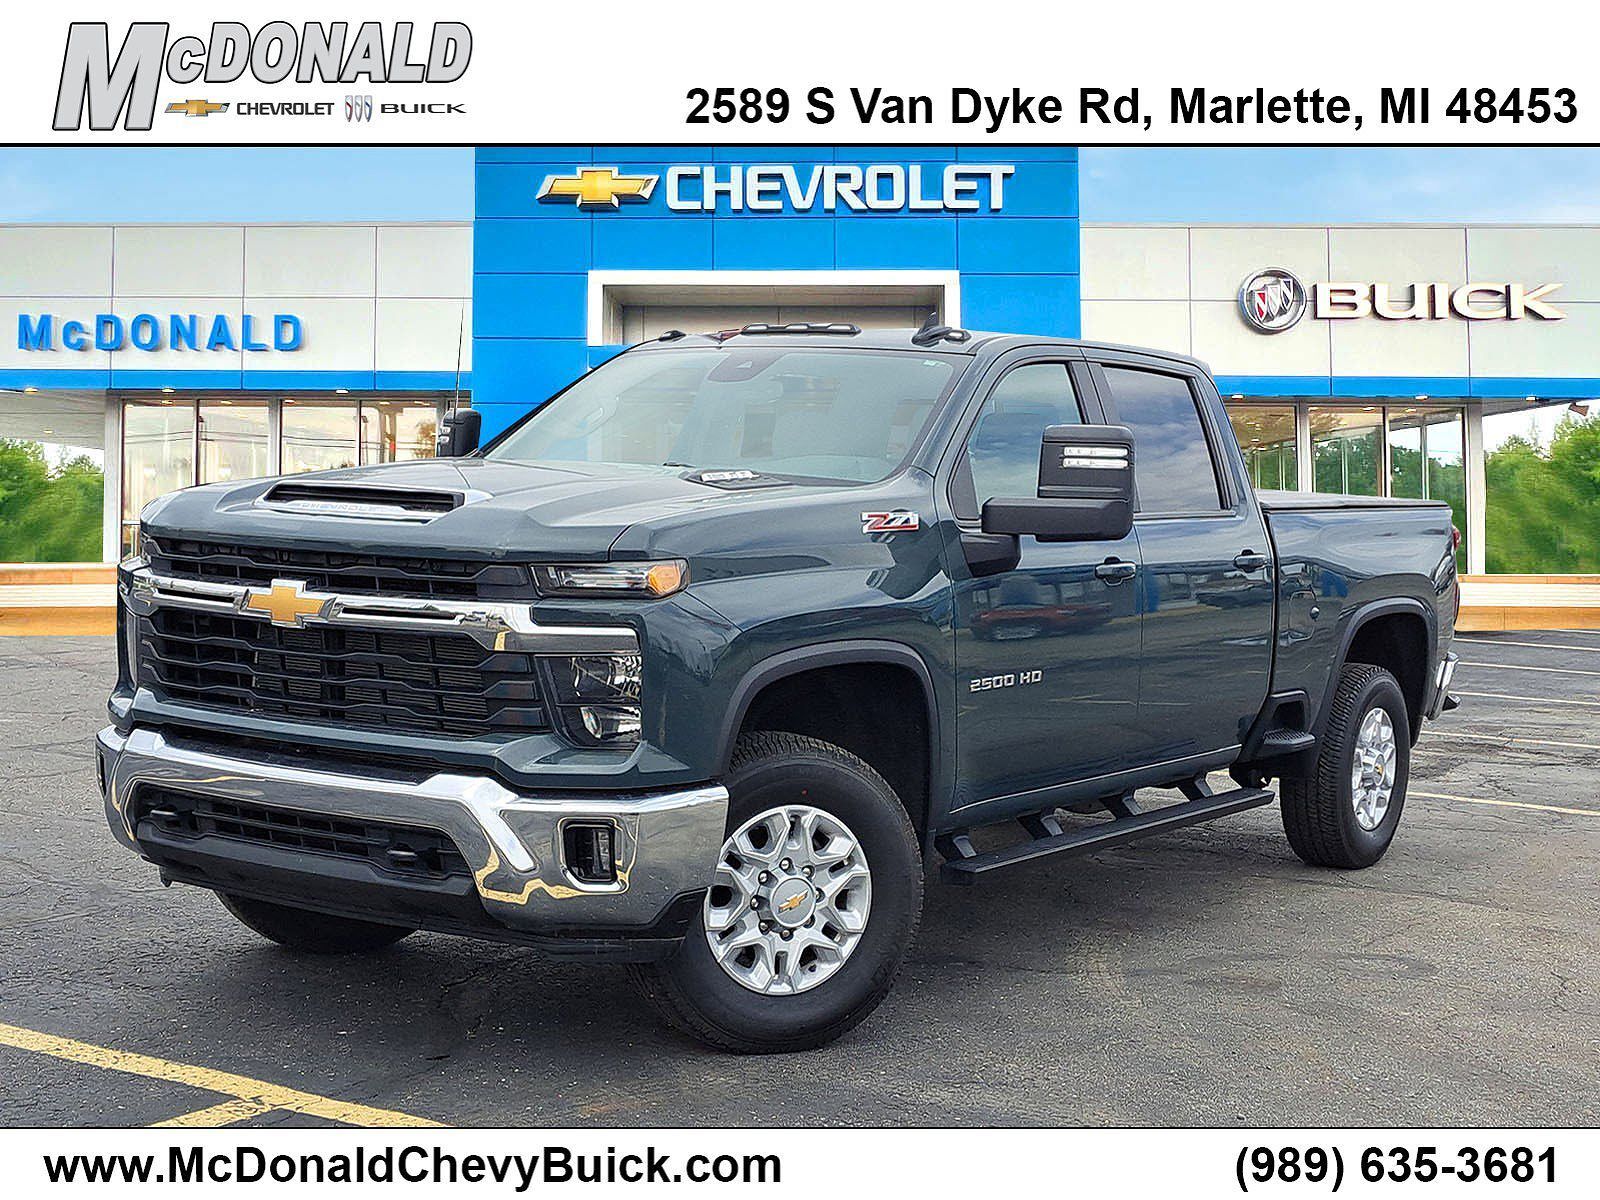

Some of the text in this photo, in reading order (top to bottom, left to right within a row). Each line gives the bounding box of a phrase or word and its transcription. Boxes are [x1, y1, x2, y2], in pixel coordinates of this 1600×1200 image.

[665, 164, 1016, 211] CHEVROLET
[1313, 281, 1567, 321] BUICK
[17, 313, 303, 352] McDONALD
[300, 501, 388, 514] CHEVROL
[860, 511, 920, 534] Z71
[969, 670, 1043, 692] 2500 HD
